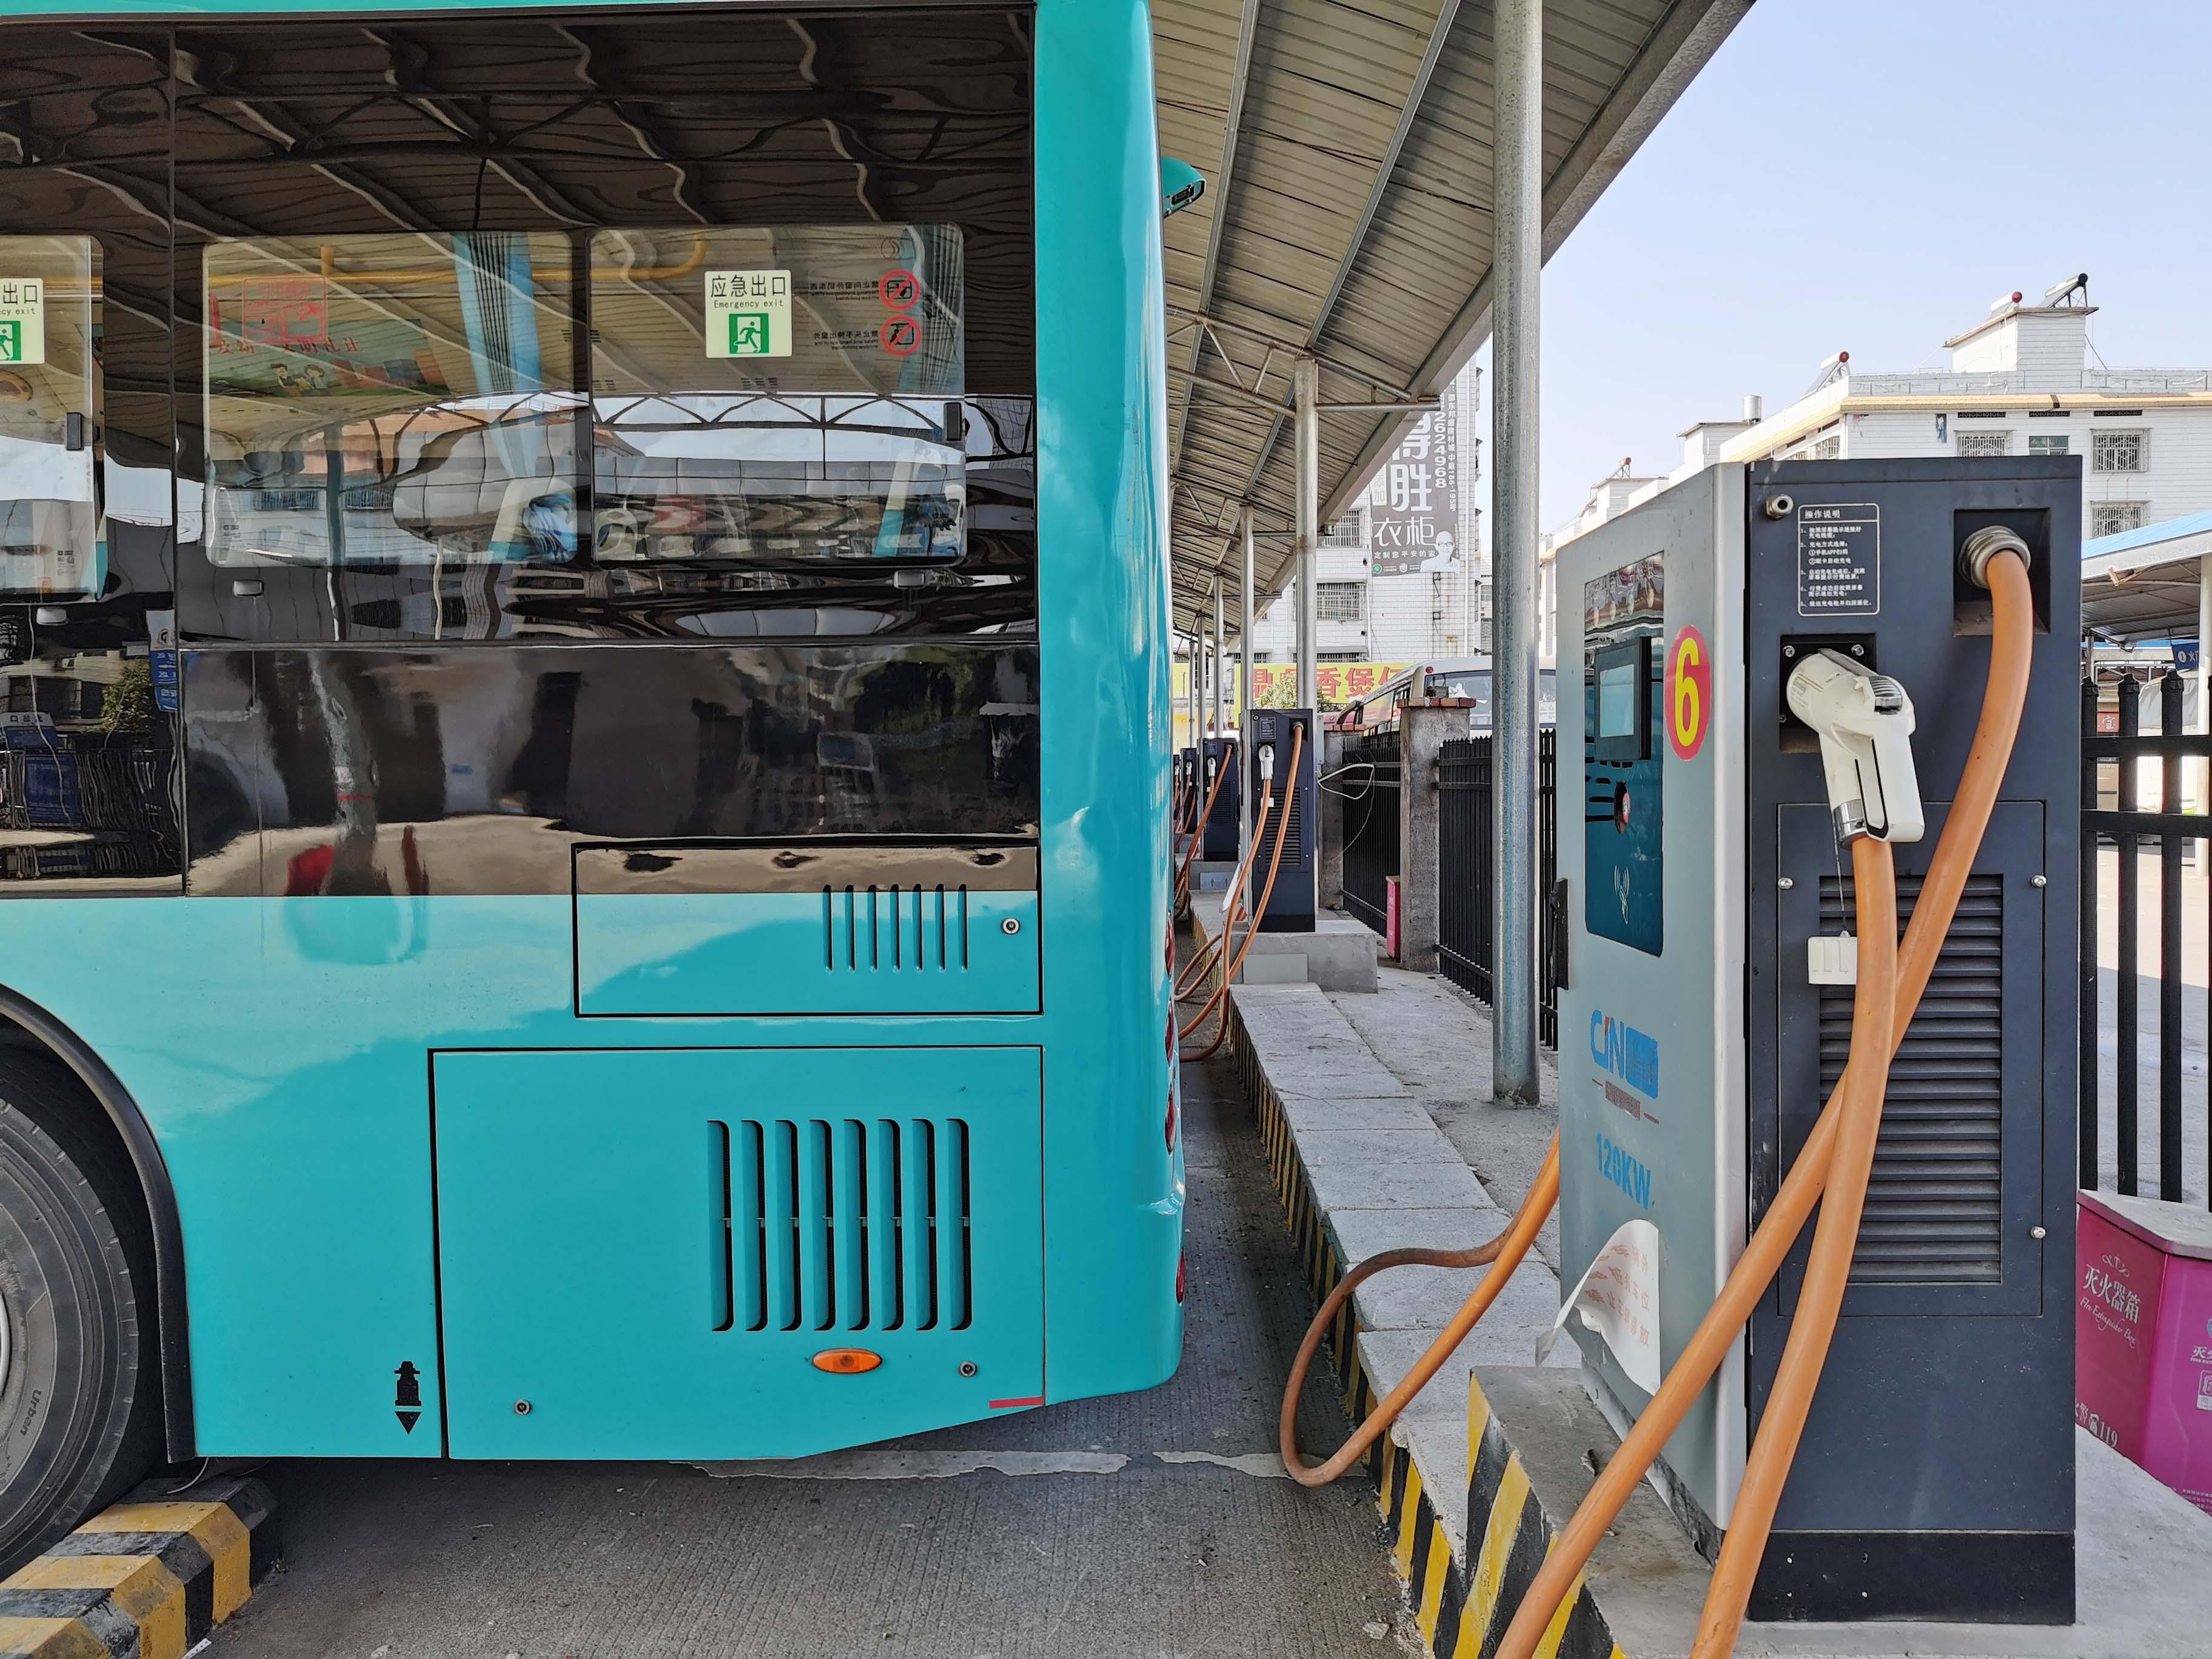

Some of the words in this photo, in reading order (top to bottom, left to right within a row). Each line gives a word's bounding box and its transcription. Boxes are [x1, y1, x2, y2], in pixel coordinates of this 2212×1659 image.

[3, 282, 38, 304] 出口
[711, 274, 786, 298] 应急出口
[714, 300, 760, 309] Emergency
[763, 298, 784, 307] exit
[1433, 412, 1447, 489] 2624968
[1805, 509, 1840, 519] 操作说明
[1373, 517, 1436, 546] 衣柜
[1374, 551, 1436, 559] 定制您平安的家
[1675, 637, 1700, 747] 6
[1596, 1133, 1651, 1211] 120KW
[2083, 1264, 2140, 1324] 灭火器箱
[20, 1389, 42, 1436] Urban
[2100, 1420, 2118, 1448] 119
